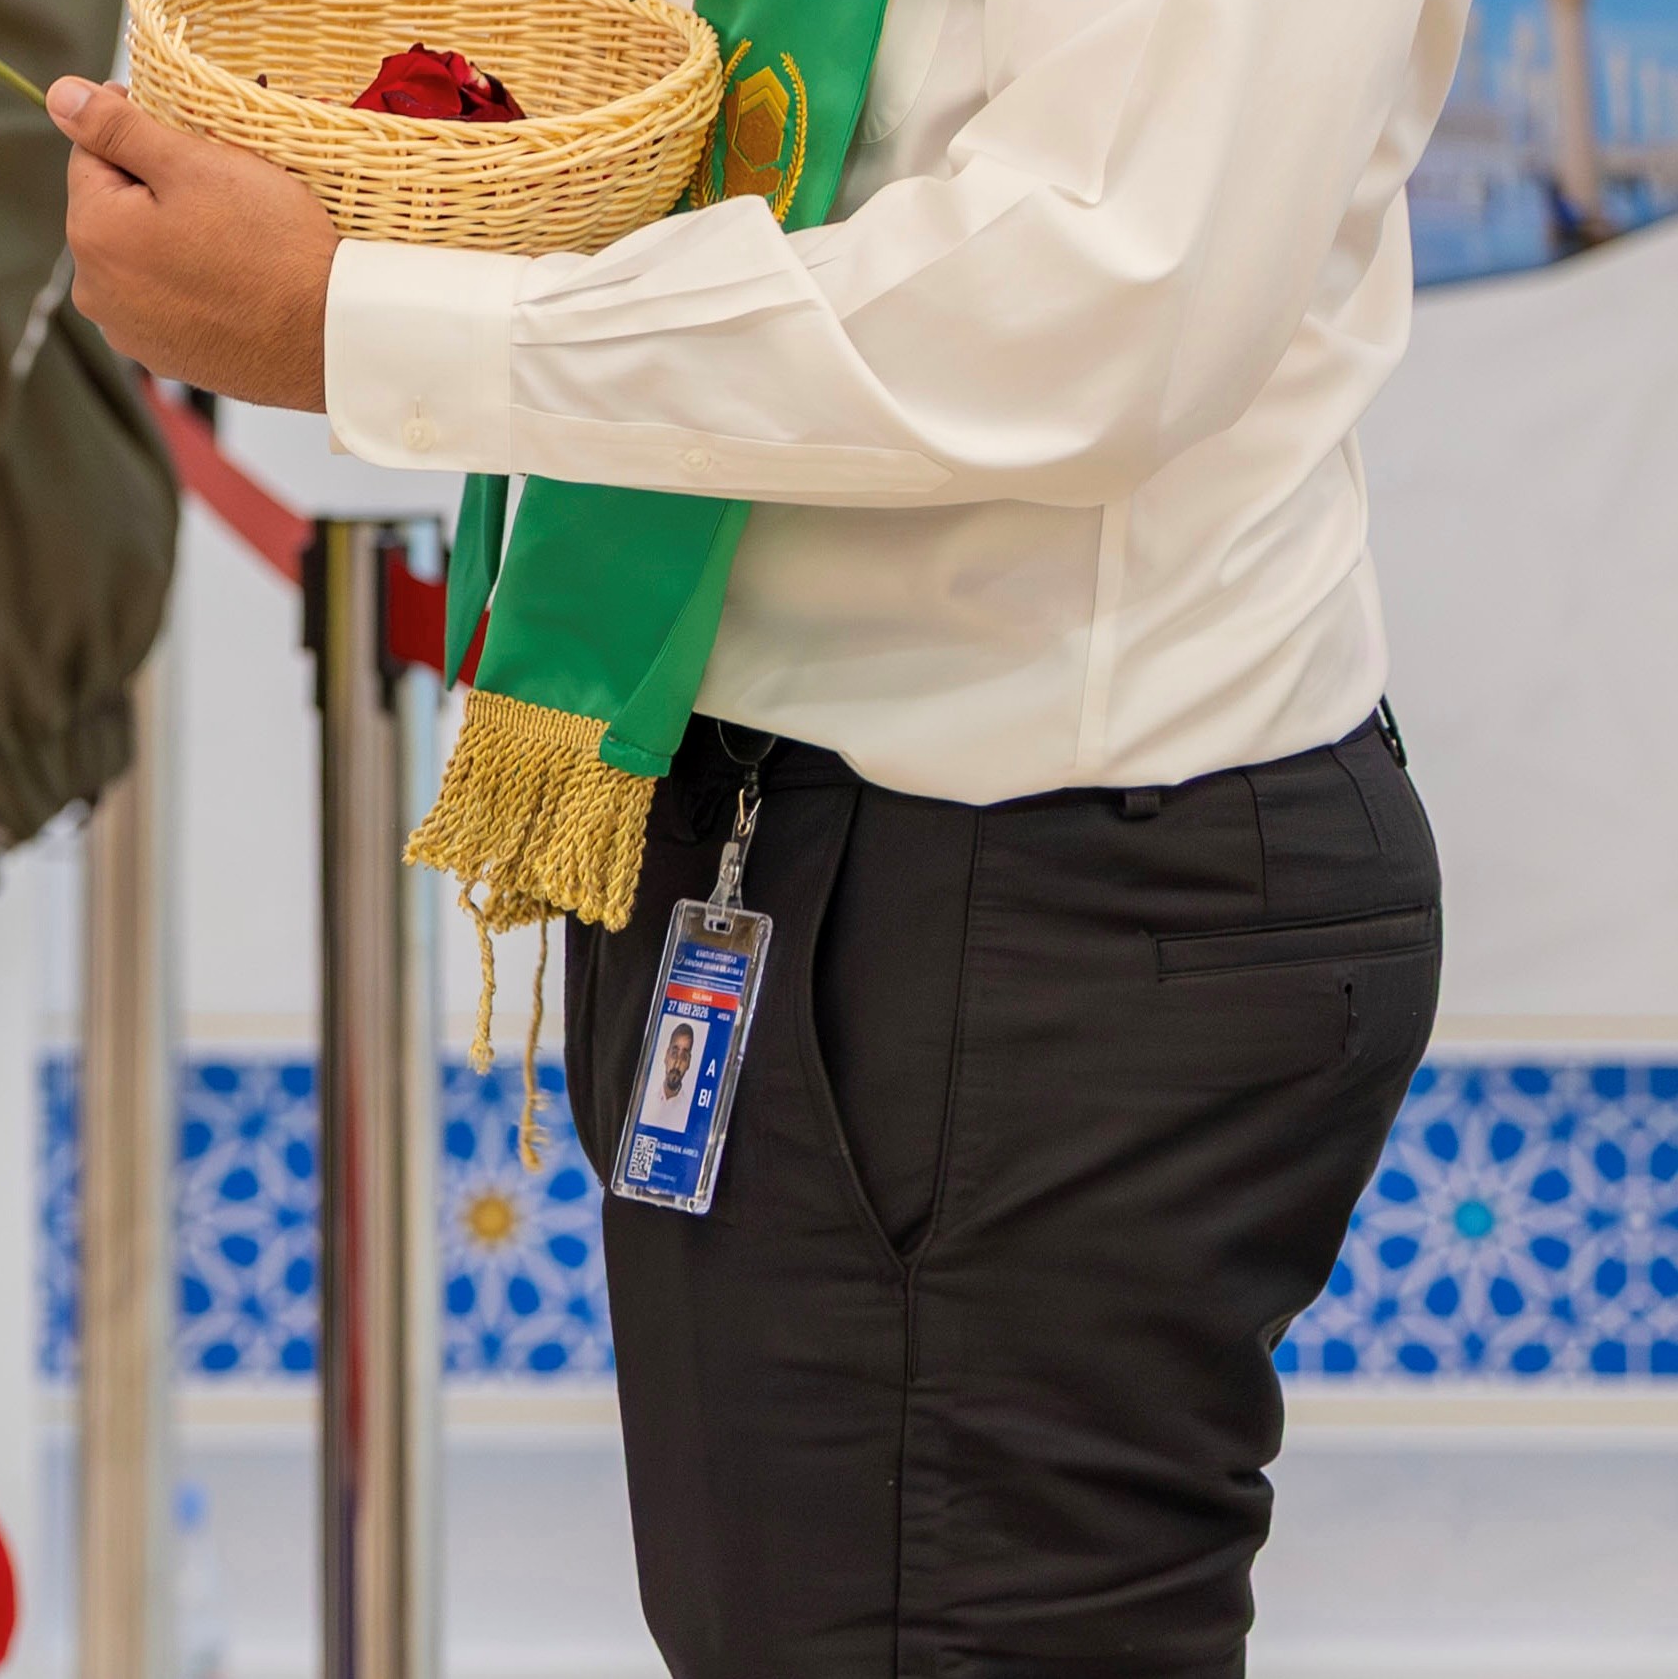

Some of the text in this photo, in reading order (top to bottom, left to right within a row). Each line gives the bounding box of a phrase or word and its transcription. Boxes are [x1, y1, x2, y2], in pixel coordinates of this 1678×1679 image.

[667, 1000, 675, 1011] 27
[677, 1002, 691, 1015] MEI
[691, 1005, 709, 1018] 2026
[705, 1058, 716, 1078] A
